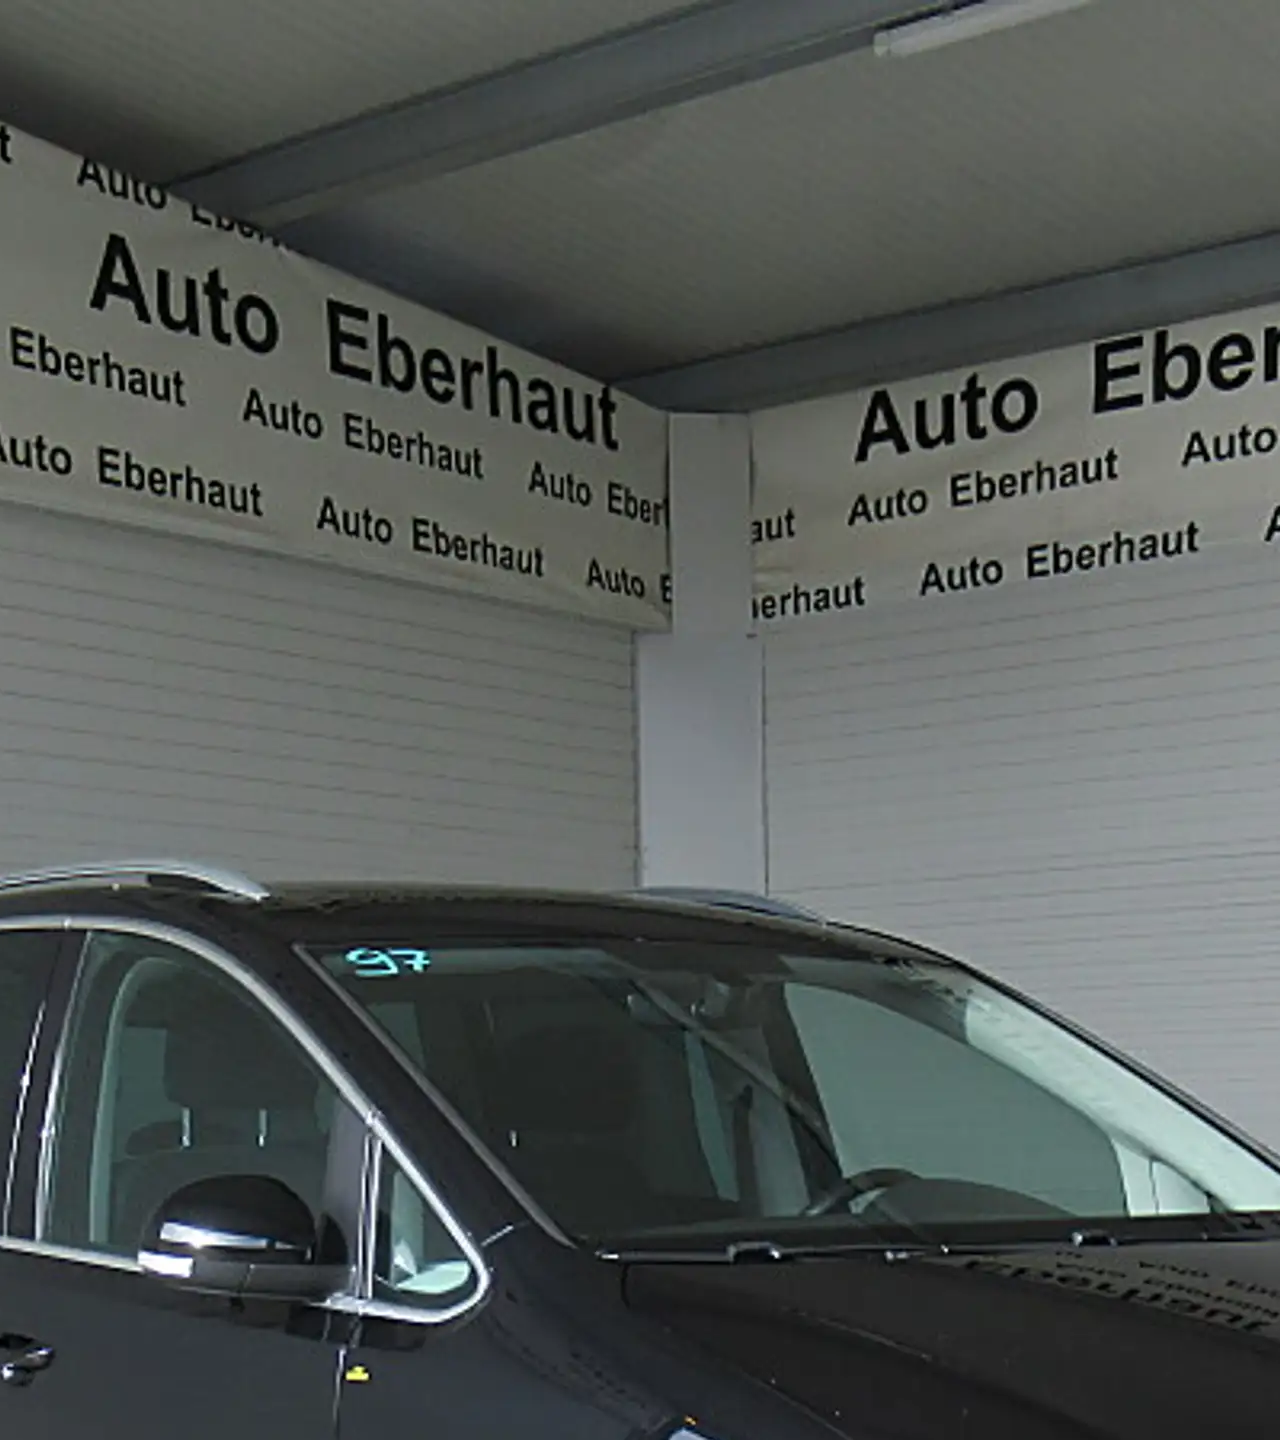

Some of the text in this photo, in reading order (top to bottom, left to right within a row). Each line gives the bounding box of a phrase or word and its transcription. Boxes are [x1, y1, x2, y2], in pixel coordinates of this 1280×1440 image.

[10, 327, 186, 407] Eberhaut
[90, 233, 620, 450] Auto Eberhaut
[243, 388, 483, 479] Auto Eberhaut
[855, 372, 1038, 462] Auto
[1182, 425, 1277, 467] Auto
[98, 446, 263, 517] Eberhaut
[529, 461, 592, 506] Auto
[848, 448, 1118, 526] Auto Eberhaut
[317, 497, 543, 577] Auto Eberhaut
[920, 522, 1198, 596] Auto Eberhaut
[586, 558, 645, 599] Auto
